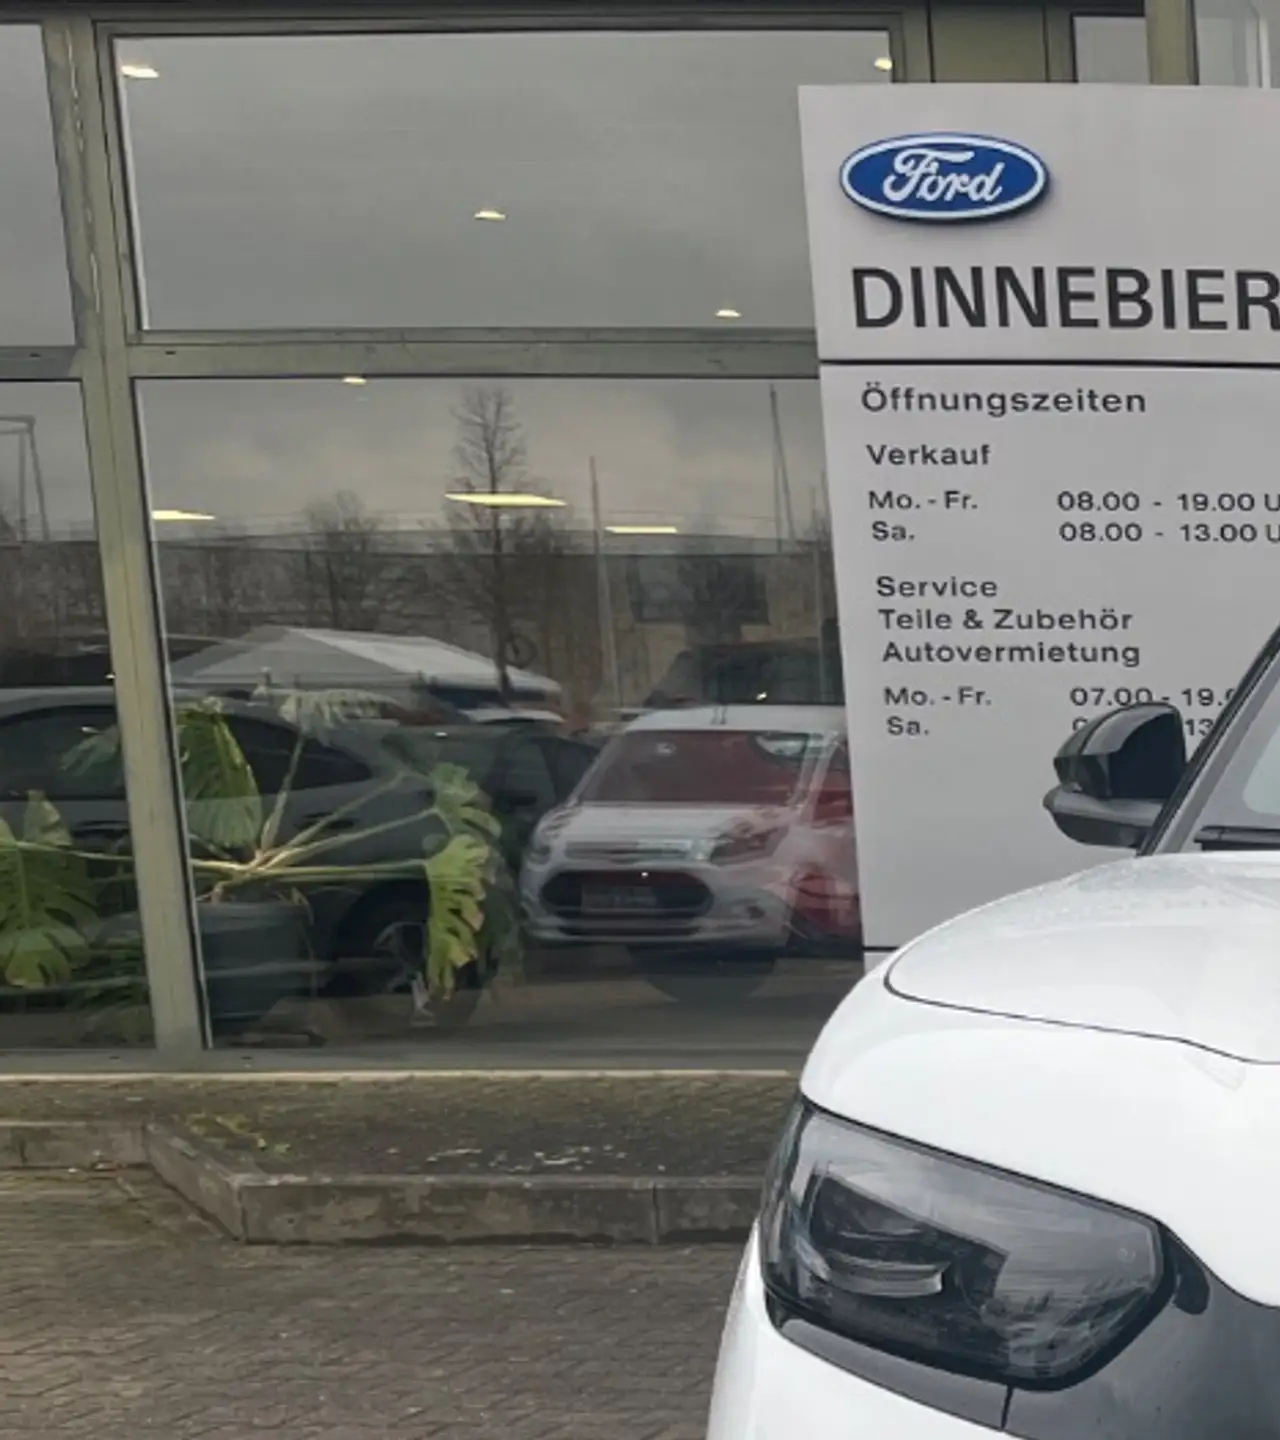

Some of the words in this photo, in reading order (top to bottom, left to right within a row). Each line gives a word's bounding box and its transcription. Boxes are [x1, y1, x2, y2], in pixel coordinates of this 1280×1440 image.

[882, 147, 1004, 203] Ford
[861, 381, 1147, 418] Öffnungszeiten
[865, 444, 991, 466] Verkauf
[867, 490, 922, 510] Mo.
[943, 490, 979, 510] Fr.
[1056, 490, 1141, 512] 08.00
[1176, 492, 1257, 513] 19.00
[870, 520, 916, 542] Sa.
[1058, 521, 1144, 543] 08.00
[1179, 522, 1259, 544] 13.00
[876, 575, 999, 599] Service
[877, 608, 953, 631] Teile
[961, 608, 985, 631] &
[992, 607, 1134, 631] Zubehör
[881, 641, 1141, 669] Autovermietung
[883, 686, 936, 706] Mo.
[957, 686, 992, 706] Fr.
[1069, 687, 1154, 707] 07.00
[886, 715, 930, 737] Sa.
